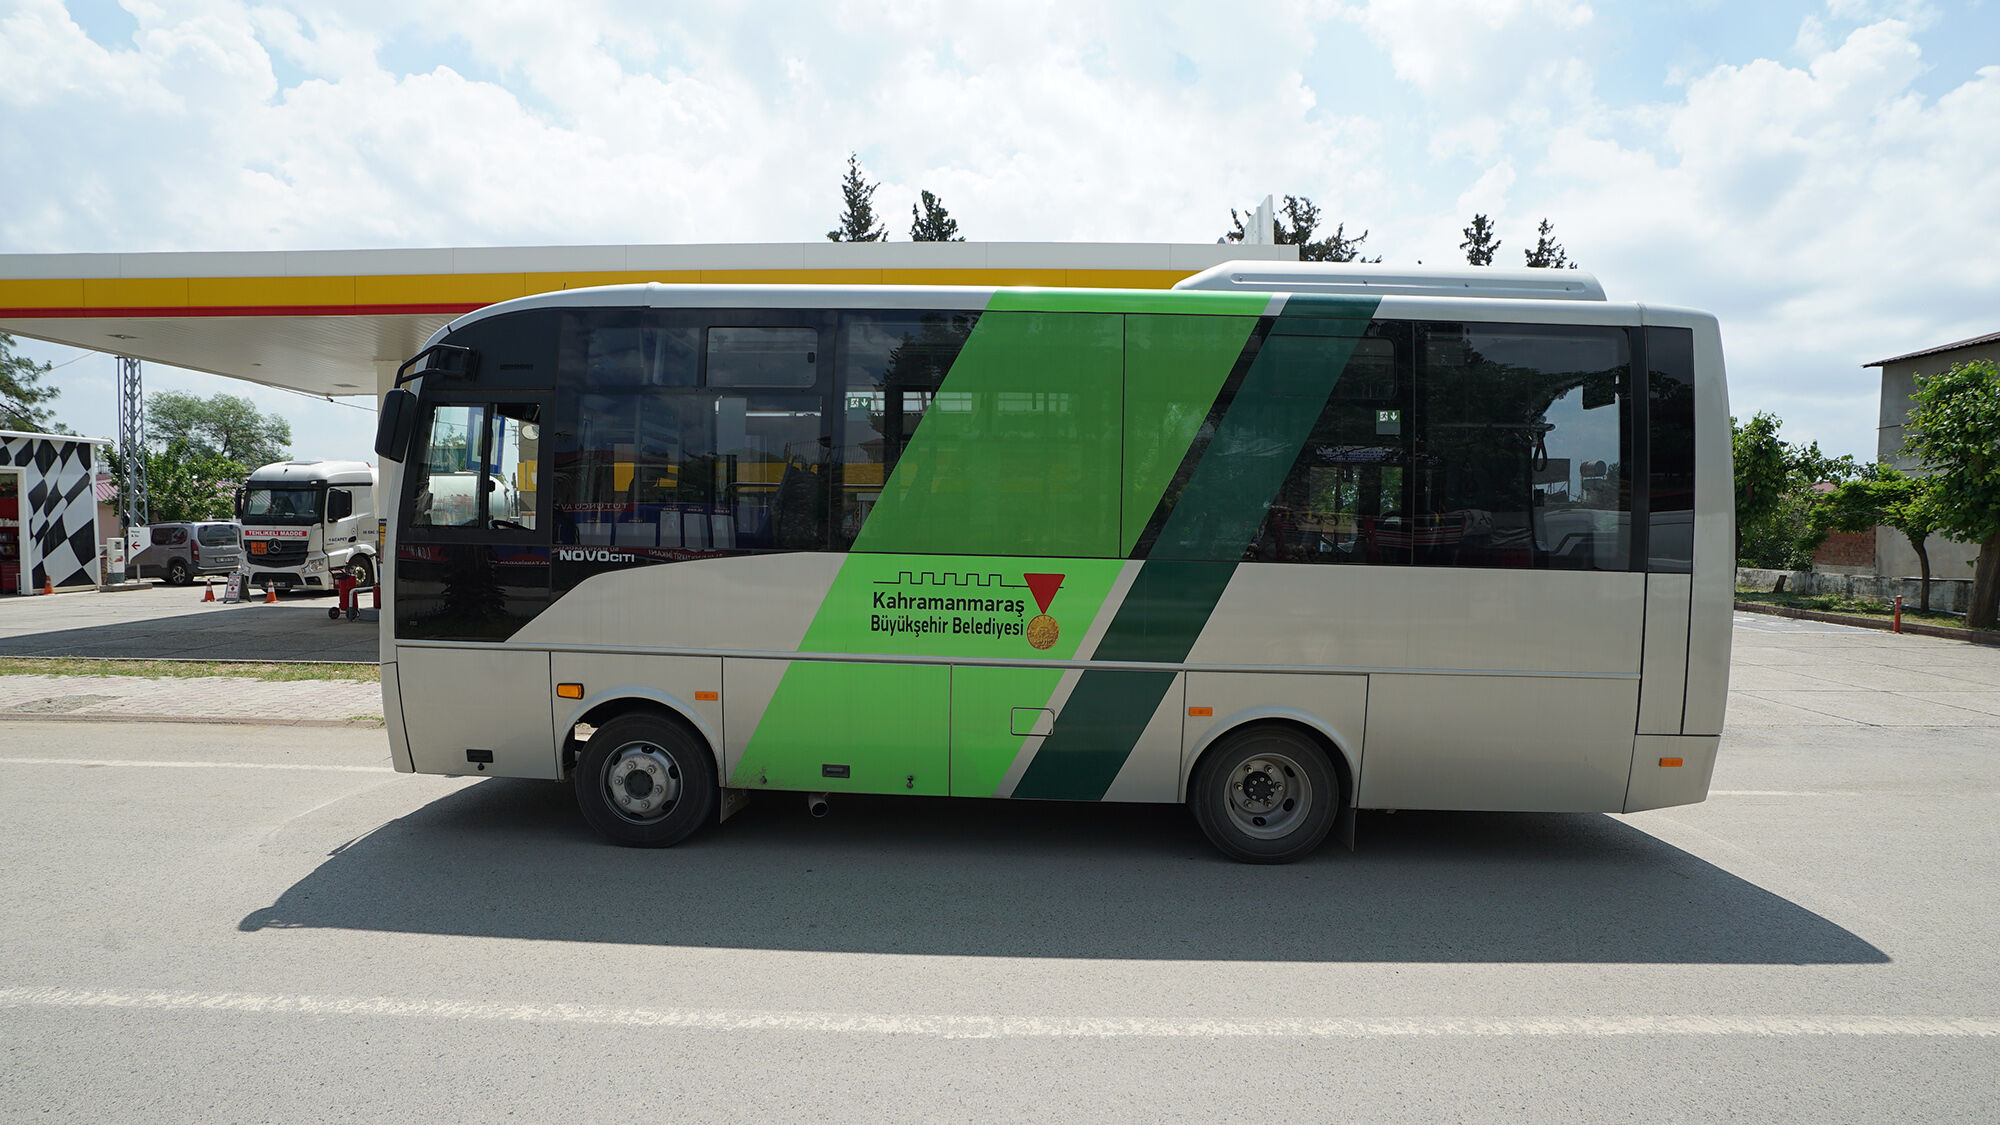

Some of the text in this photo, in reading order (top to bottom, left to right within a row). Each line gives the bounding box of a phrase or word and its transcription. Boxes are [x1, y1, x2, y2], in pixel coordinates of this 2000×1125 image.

[873, 591, 1025, 617] Kahramanmaraş
[871, 614, 1024, 640] Büyükşehir Belediyesi
